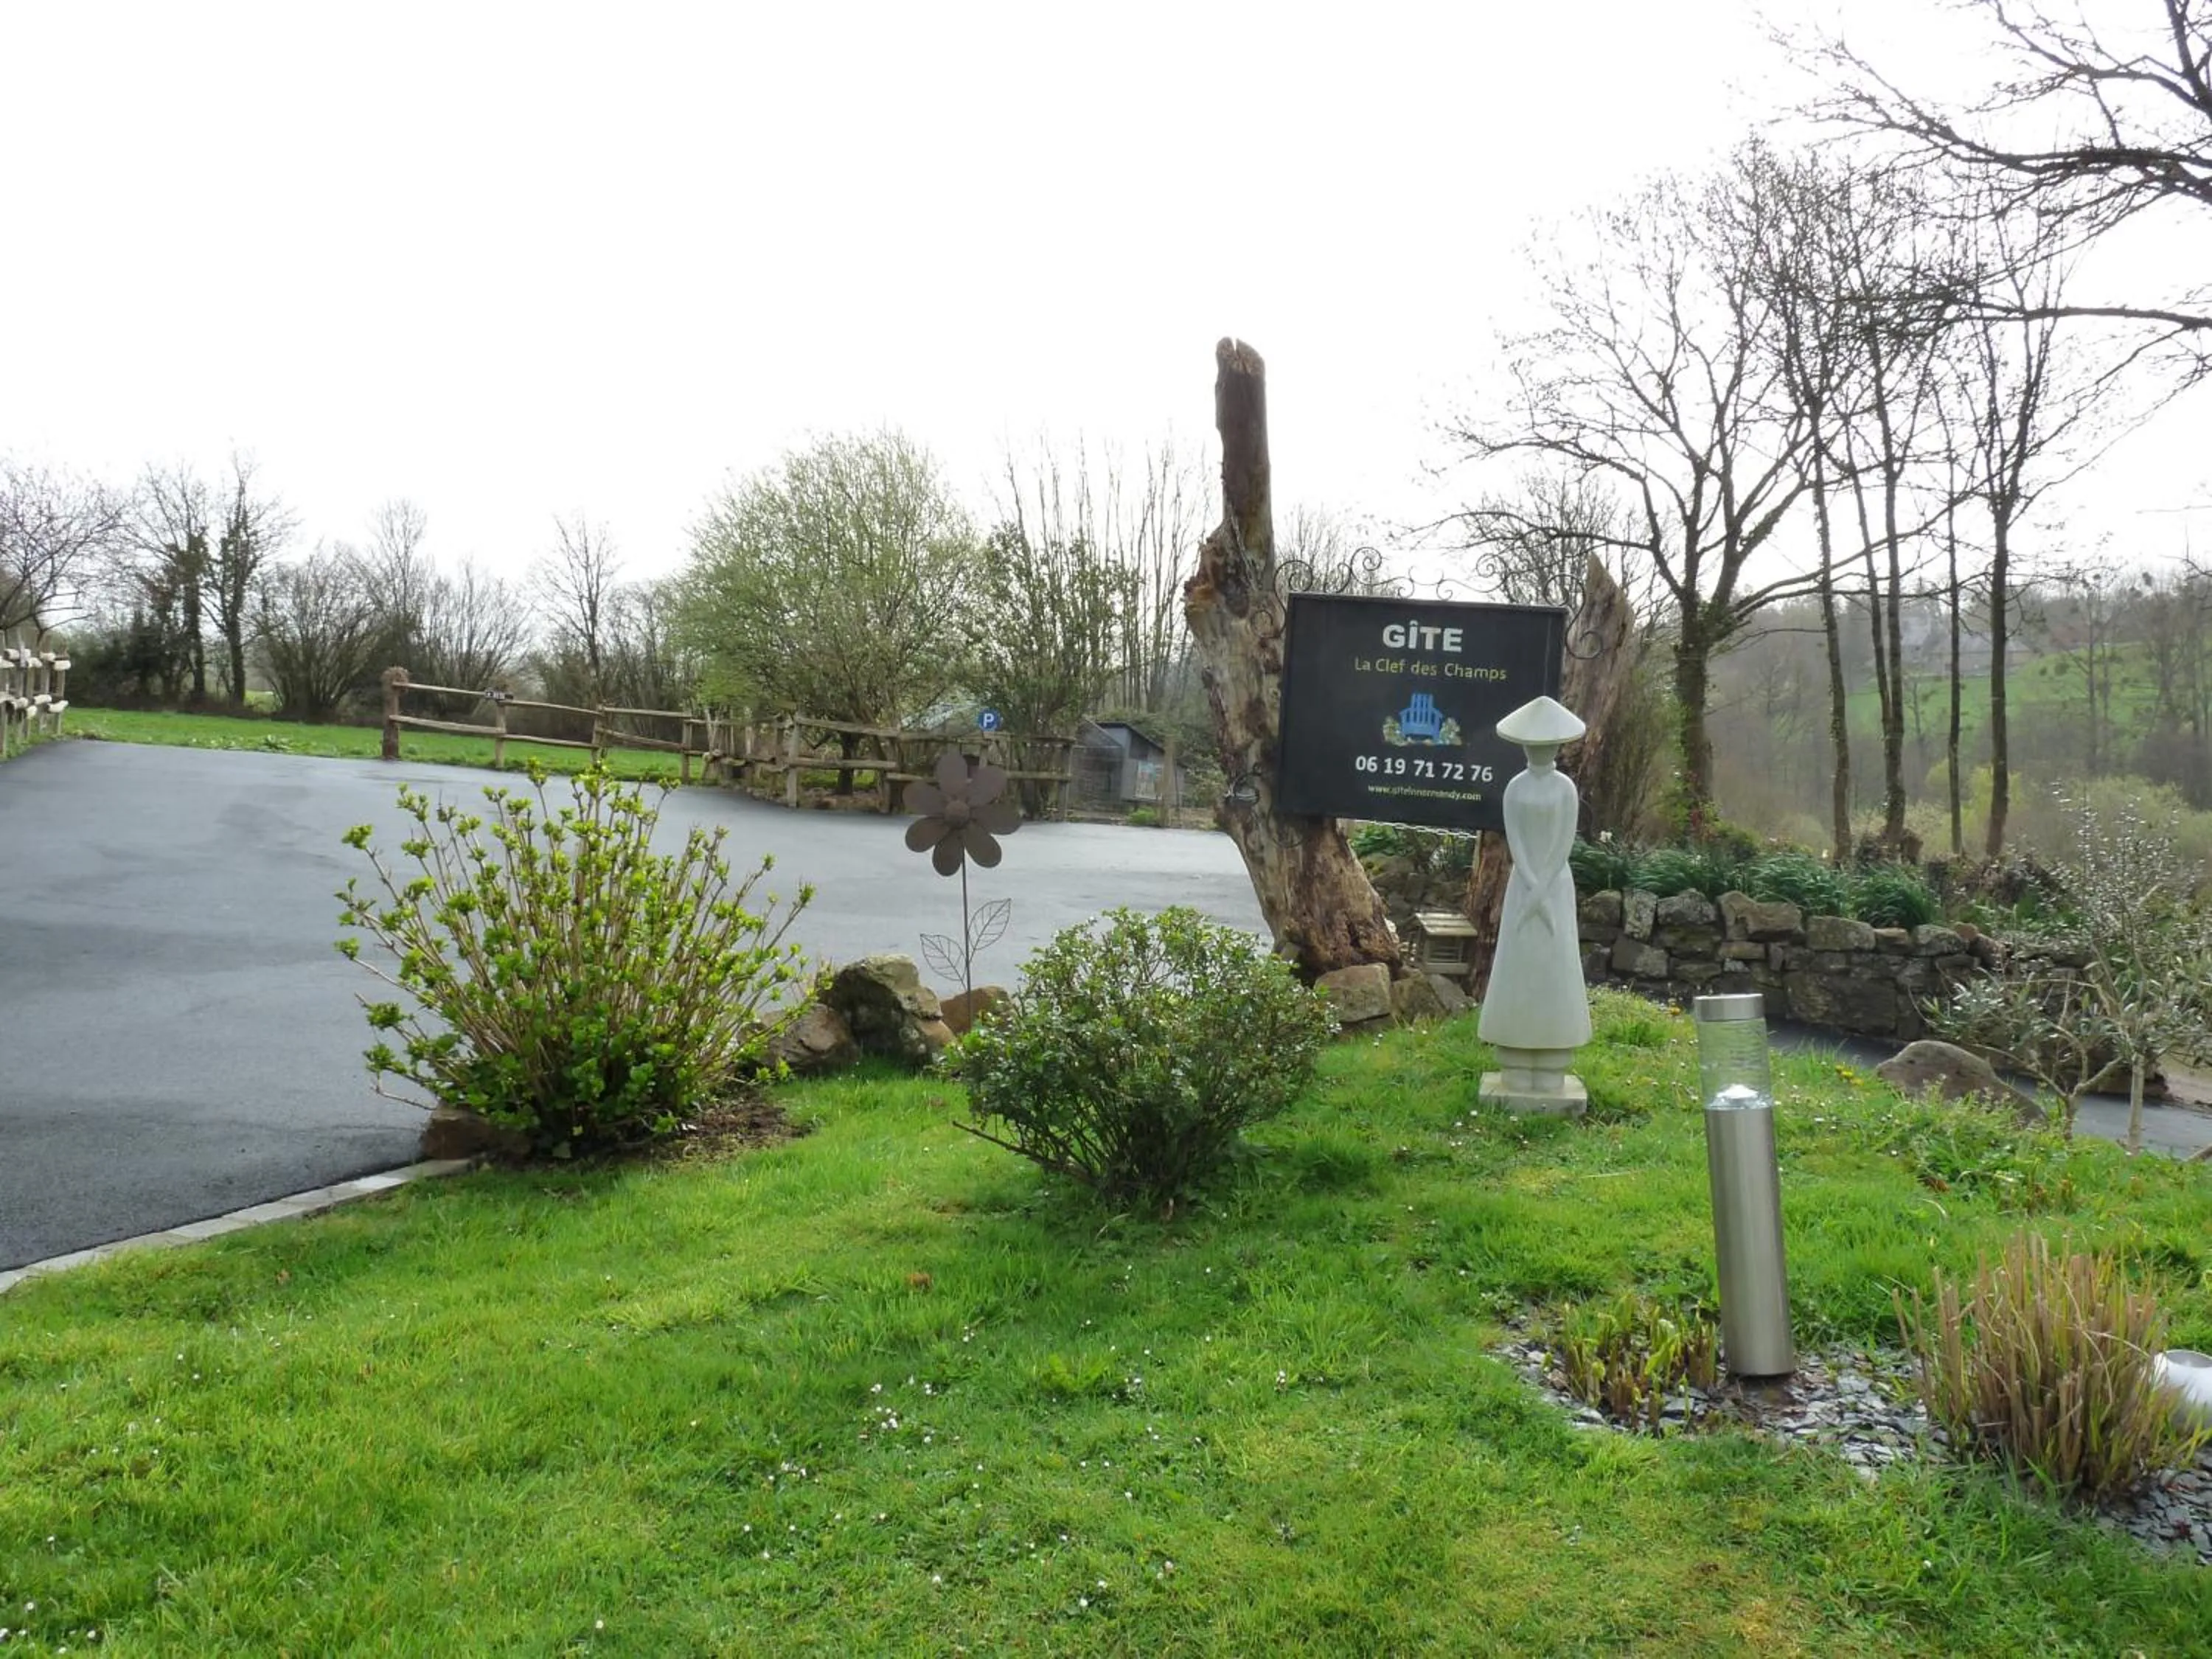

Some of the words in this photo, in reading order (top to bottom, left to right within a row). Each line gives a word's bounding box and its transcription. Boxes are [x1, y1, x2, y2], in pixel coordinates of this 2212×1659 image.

[1382, 619, 1463, 653] GÎTE
[1354, 657, 1371, 672] La
[1375, 658, 1405, 674] Clef
[1411, 660, 1437, 676] des
[1444, 662, 1506, 682] Champs
[984, 713, 995, 728] P
[1355, 756, 1377, 773] 06
[1384, 758, 1406, 775] 19
[1413, 759, 1436, 778] 71
[1441, 762, 1464, 780] 72
[1470, 765, 1493, 782] 76
